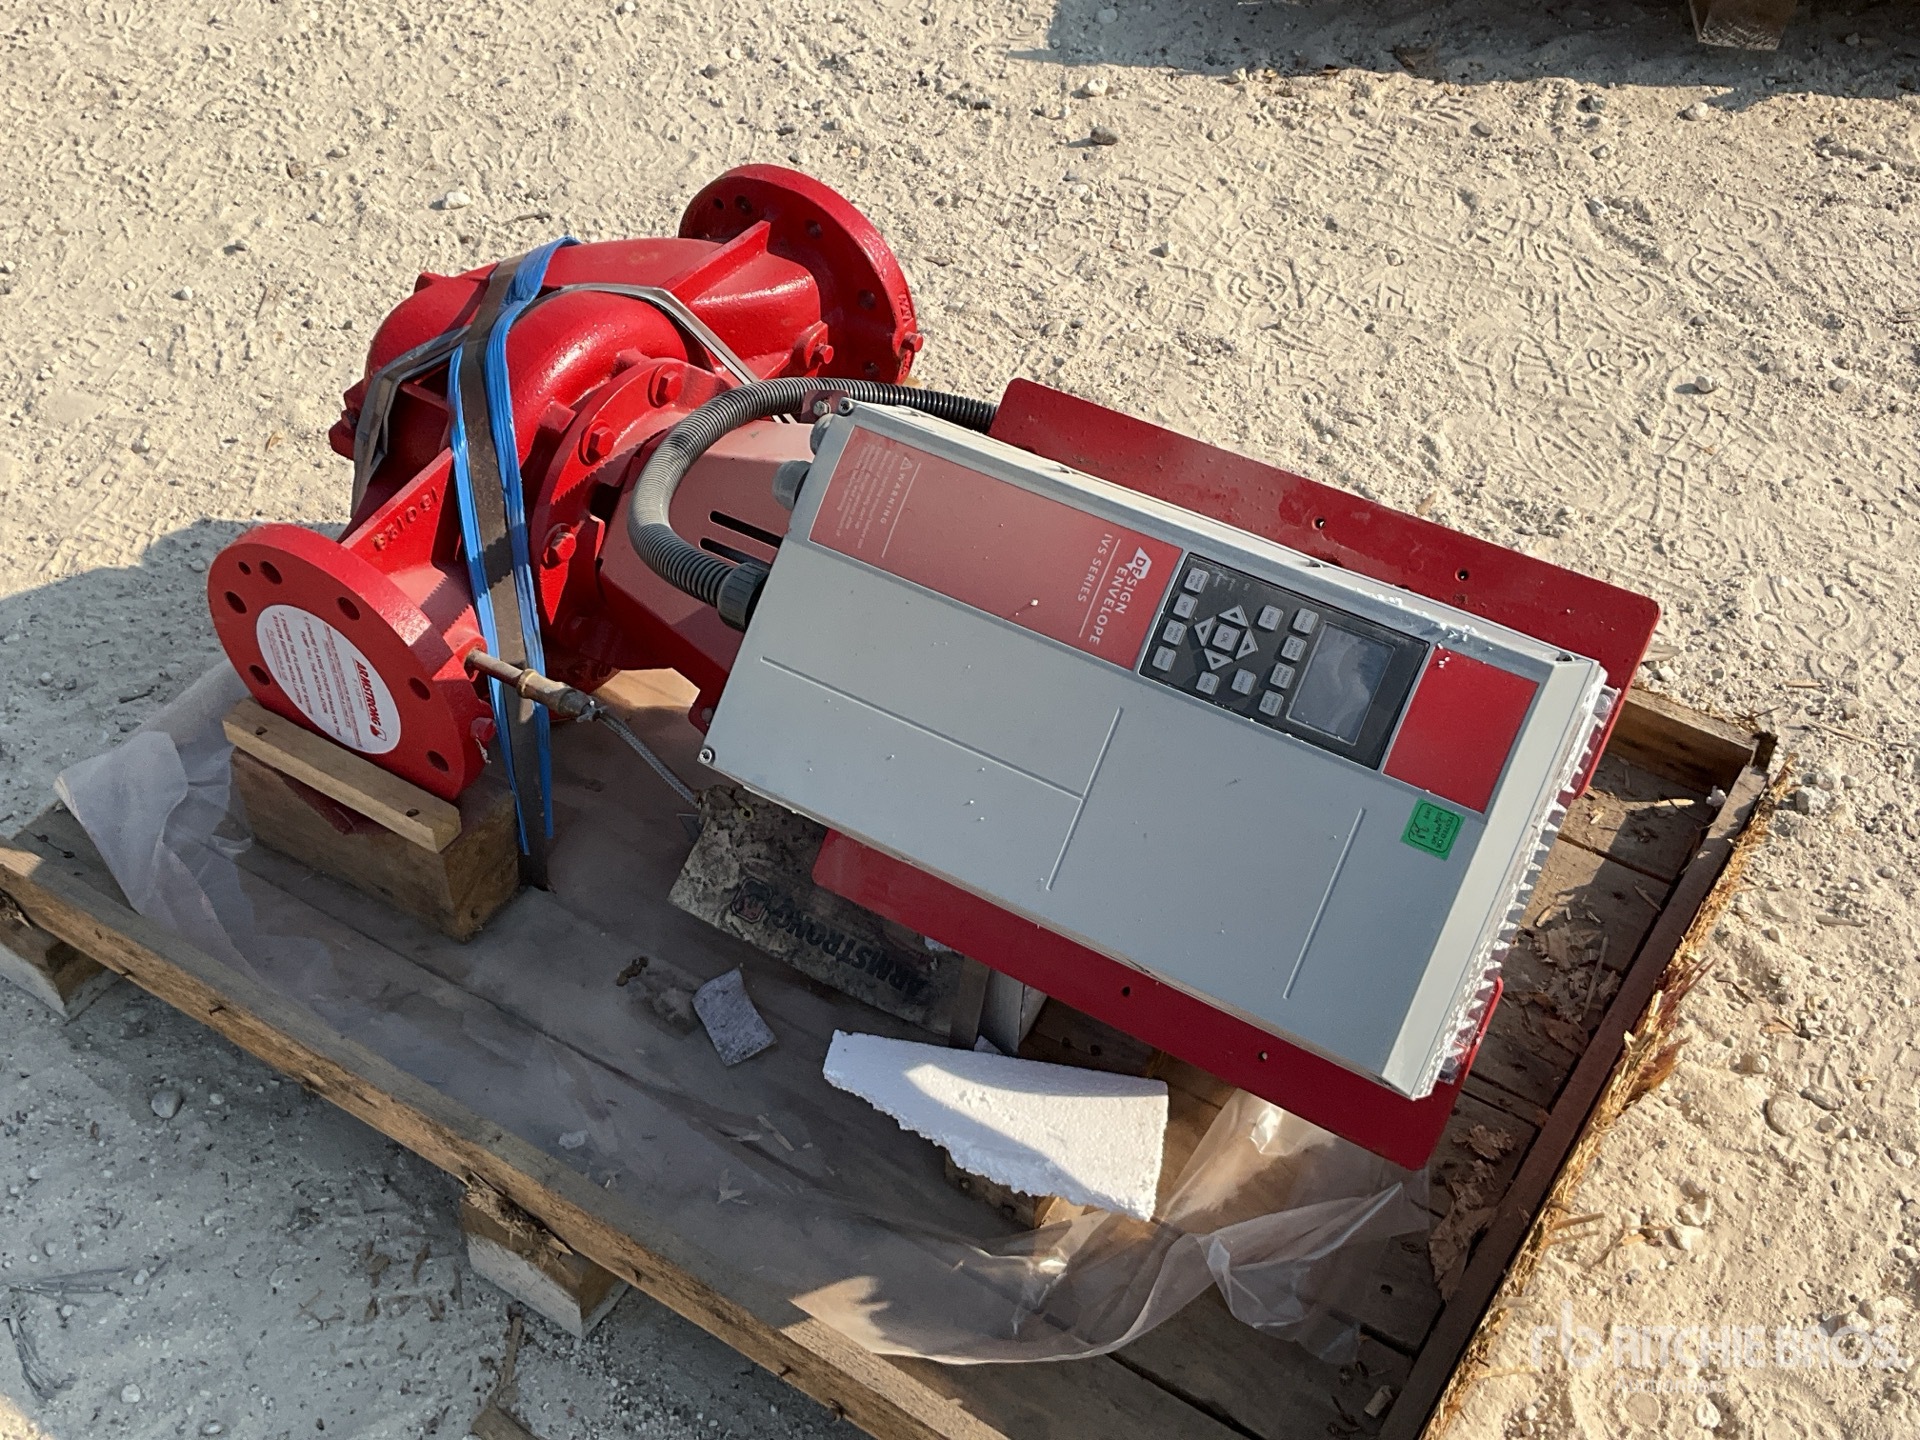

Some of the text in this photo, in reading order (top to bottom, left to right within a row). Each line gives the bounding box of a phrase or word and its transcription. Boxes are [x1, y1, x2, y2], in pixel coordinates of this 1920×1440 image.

[880, 473, 905, 525] WARNING
[1077, 533, 1113, 603] IVS SERIES
[1115, 557, 1147, 614] DESIGN
[1089, 567, 1128, 645] ENVELOPE
[1181, 601, 1189, 611] Off
[1220, 632, 1230, 643] OK
[272, 615, 284, 640] SYSTEM
[280, 640, 291, 664] BEFORE
[287, 664, 303, 704] INSTALLATION
[281, 618, 293, 643] ENSURE
[293, 656, 305, 685] FLUSHING
[303, 694, 314, 716] ENTIRE
[301, 631, 309, 648] PUMP
[313, 674, 328, 714] INSTALLATION
[305, 622, 317, 646] ENSURE
[313, 647, 324, 670] FLANGE
[320, 671, 331, 692] COVER
[326, 692, 336, 715] REMAIN
[331, 715, 339, 725] ON
[355, 659, 382, 727] ARMSTRONG
[1440, 816, 1454, 838] TESTED
[768, 900, 929, 1003] ARMSTRONG
